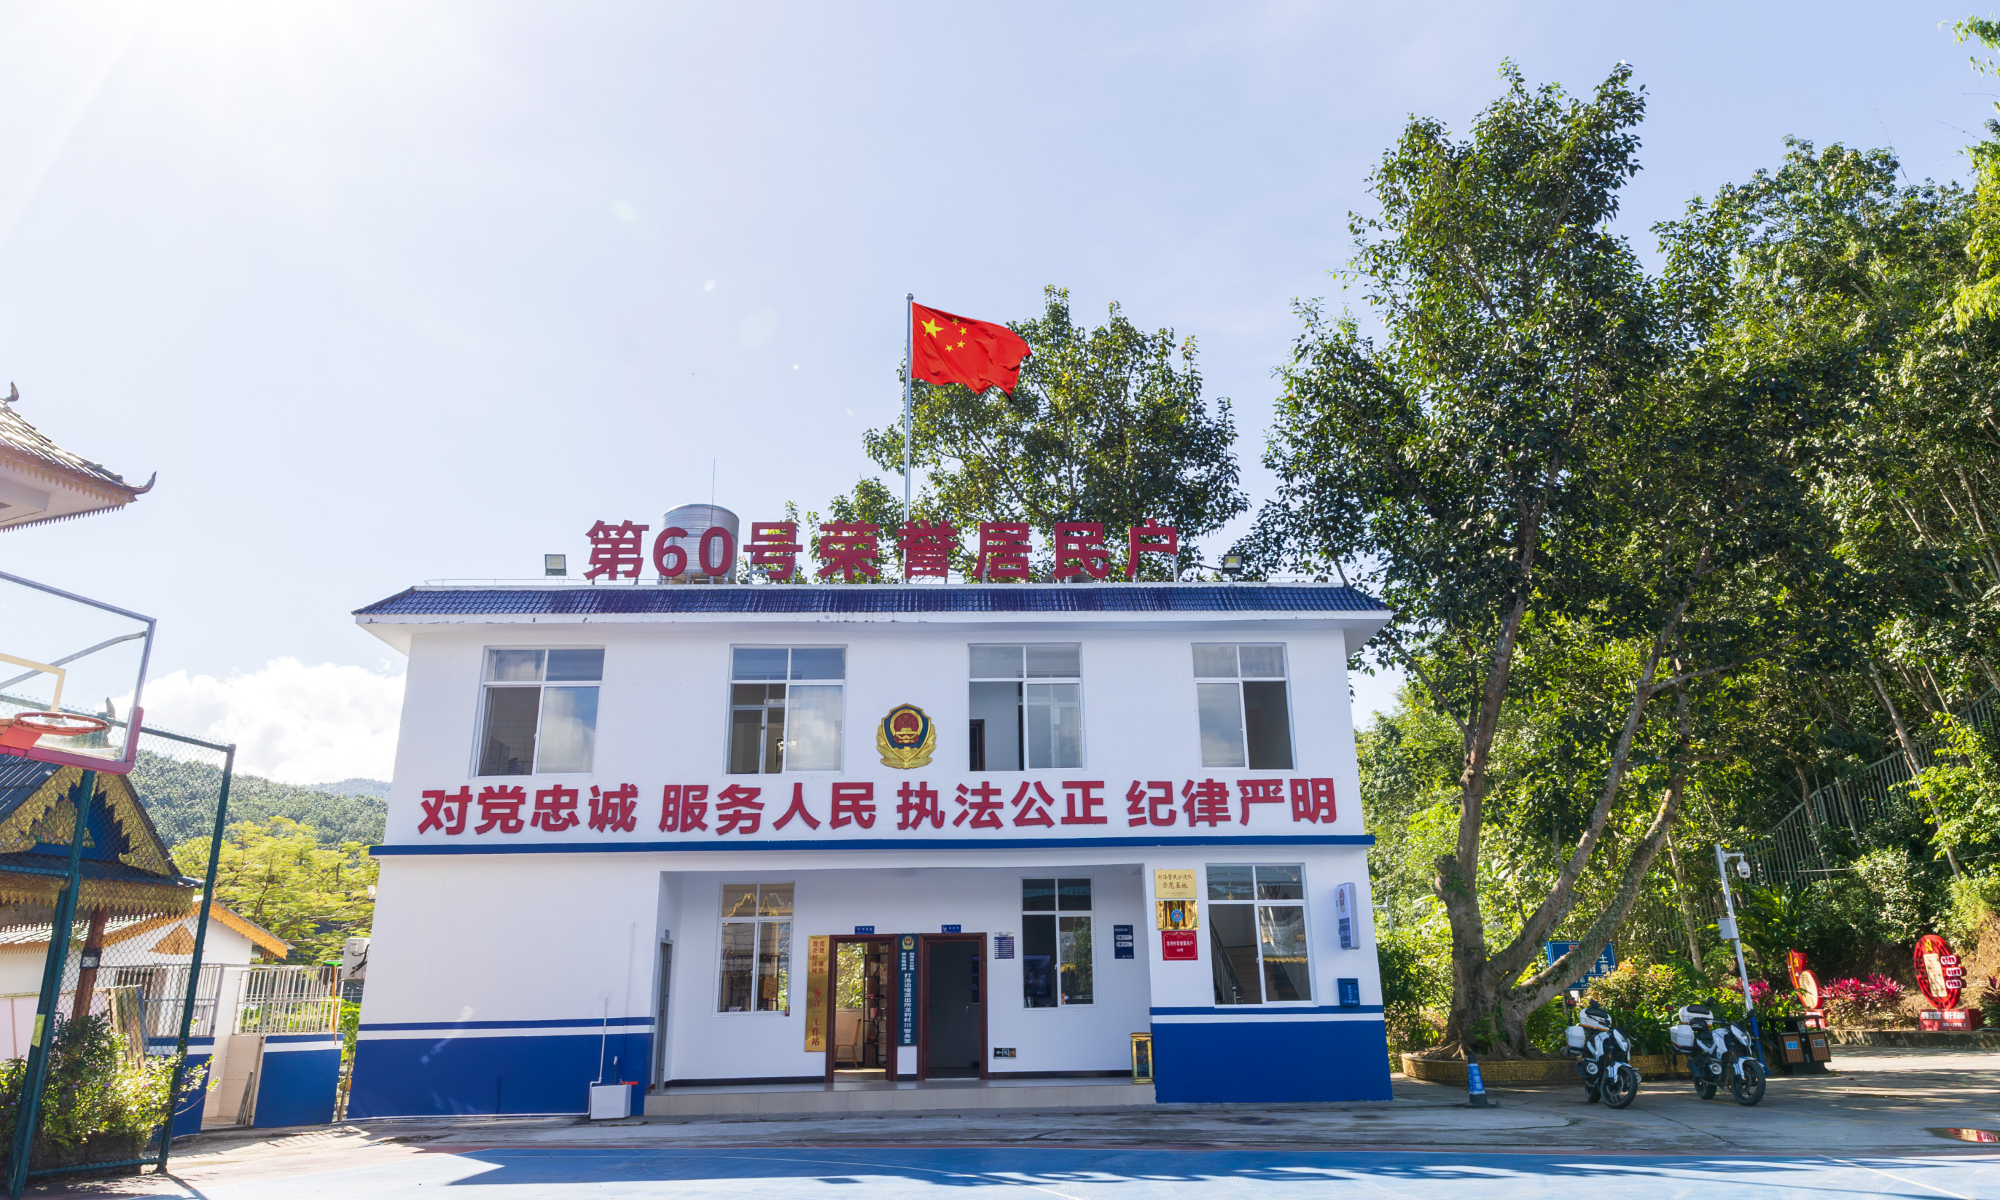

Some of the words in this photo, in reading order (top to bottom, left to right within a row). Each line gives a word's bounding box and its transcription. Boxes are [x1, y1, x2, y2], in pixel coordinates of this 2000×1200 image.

[583, 518, 1178, 580] 第60号荣誉居民户
[418, 783, 639, 835] 对党忠诚
[658, 781, 876, 835] 服务人民
[896, 780, 1108, 831] 执法公正
[1126, 777, 1337, 828] 纪律严明
[811, 979, 822, 1046] 三务合一工作站
